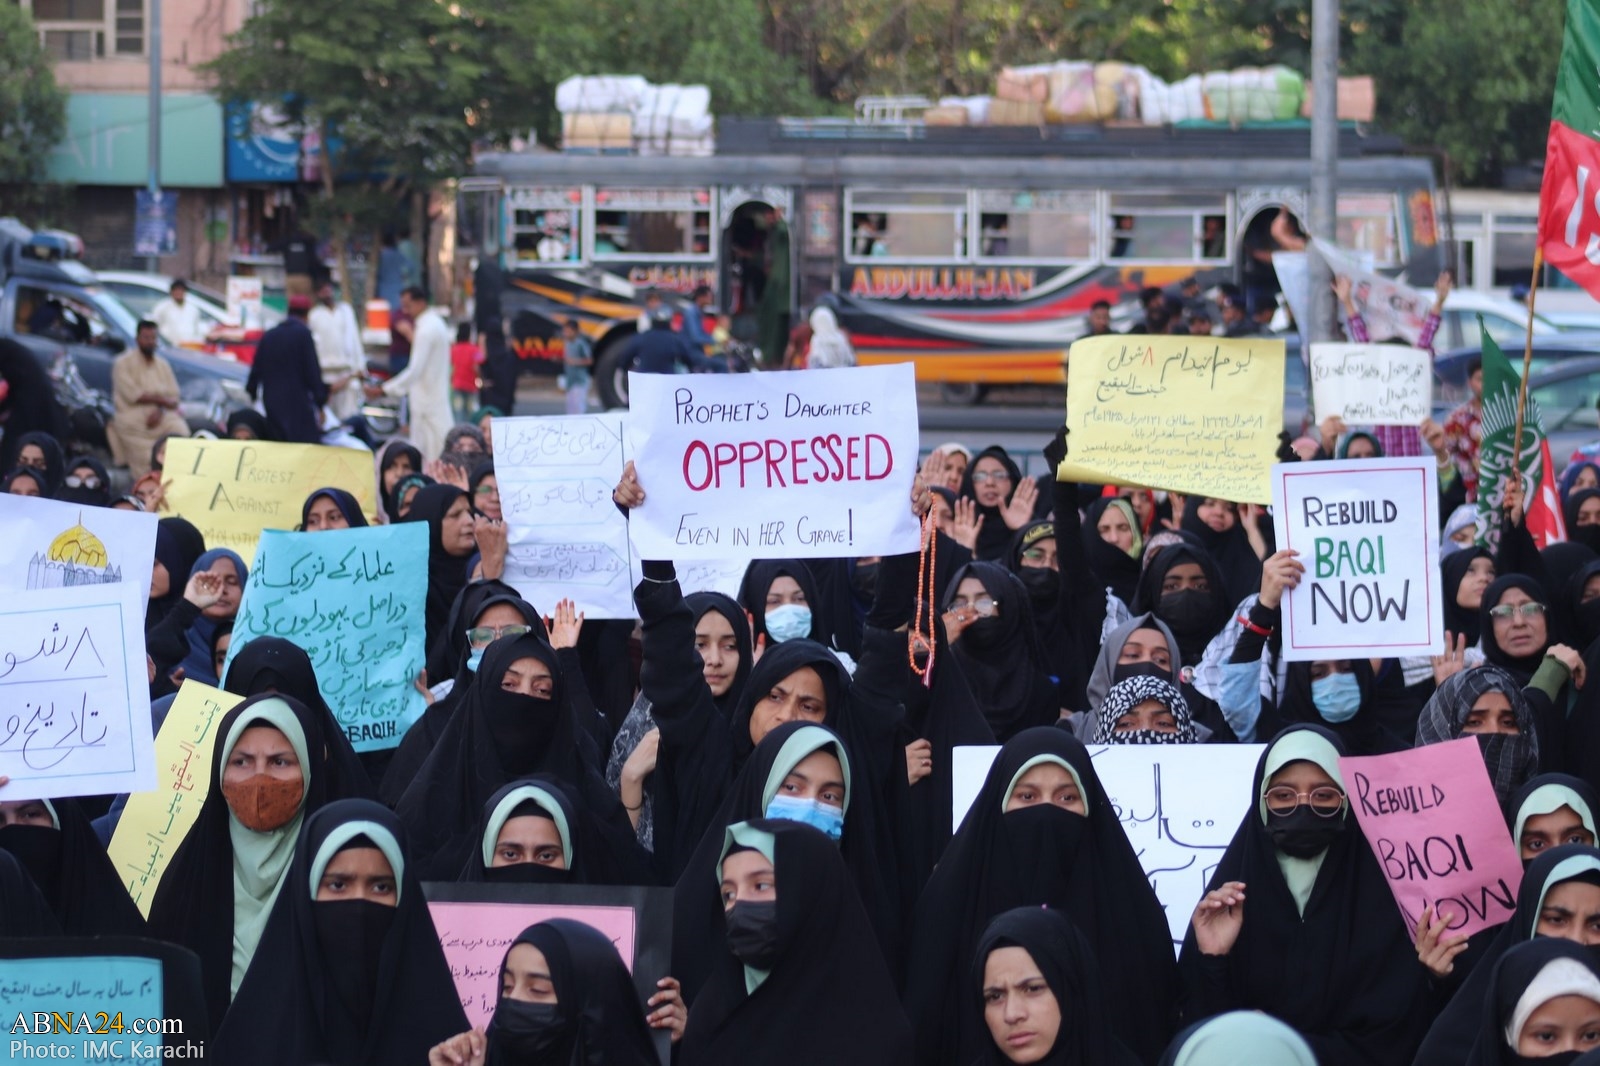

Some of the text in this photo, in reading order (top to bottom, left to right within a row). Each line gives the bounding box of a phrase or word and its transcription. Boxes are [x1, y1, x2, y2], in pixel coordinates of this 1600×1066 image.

[187, 447, 206, 477] I
[683, 433, 893, 491] OPPRESSED
[733, 527, 750, 546] IN
[759, 520, 785, 546] HER
[1314, 535, 1386, 579] BAQI
[1311, 579, 1410, 626] NOW
[1377, 834, 1473, 881] BAQI
